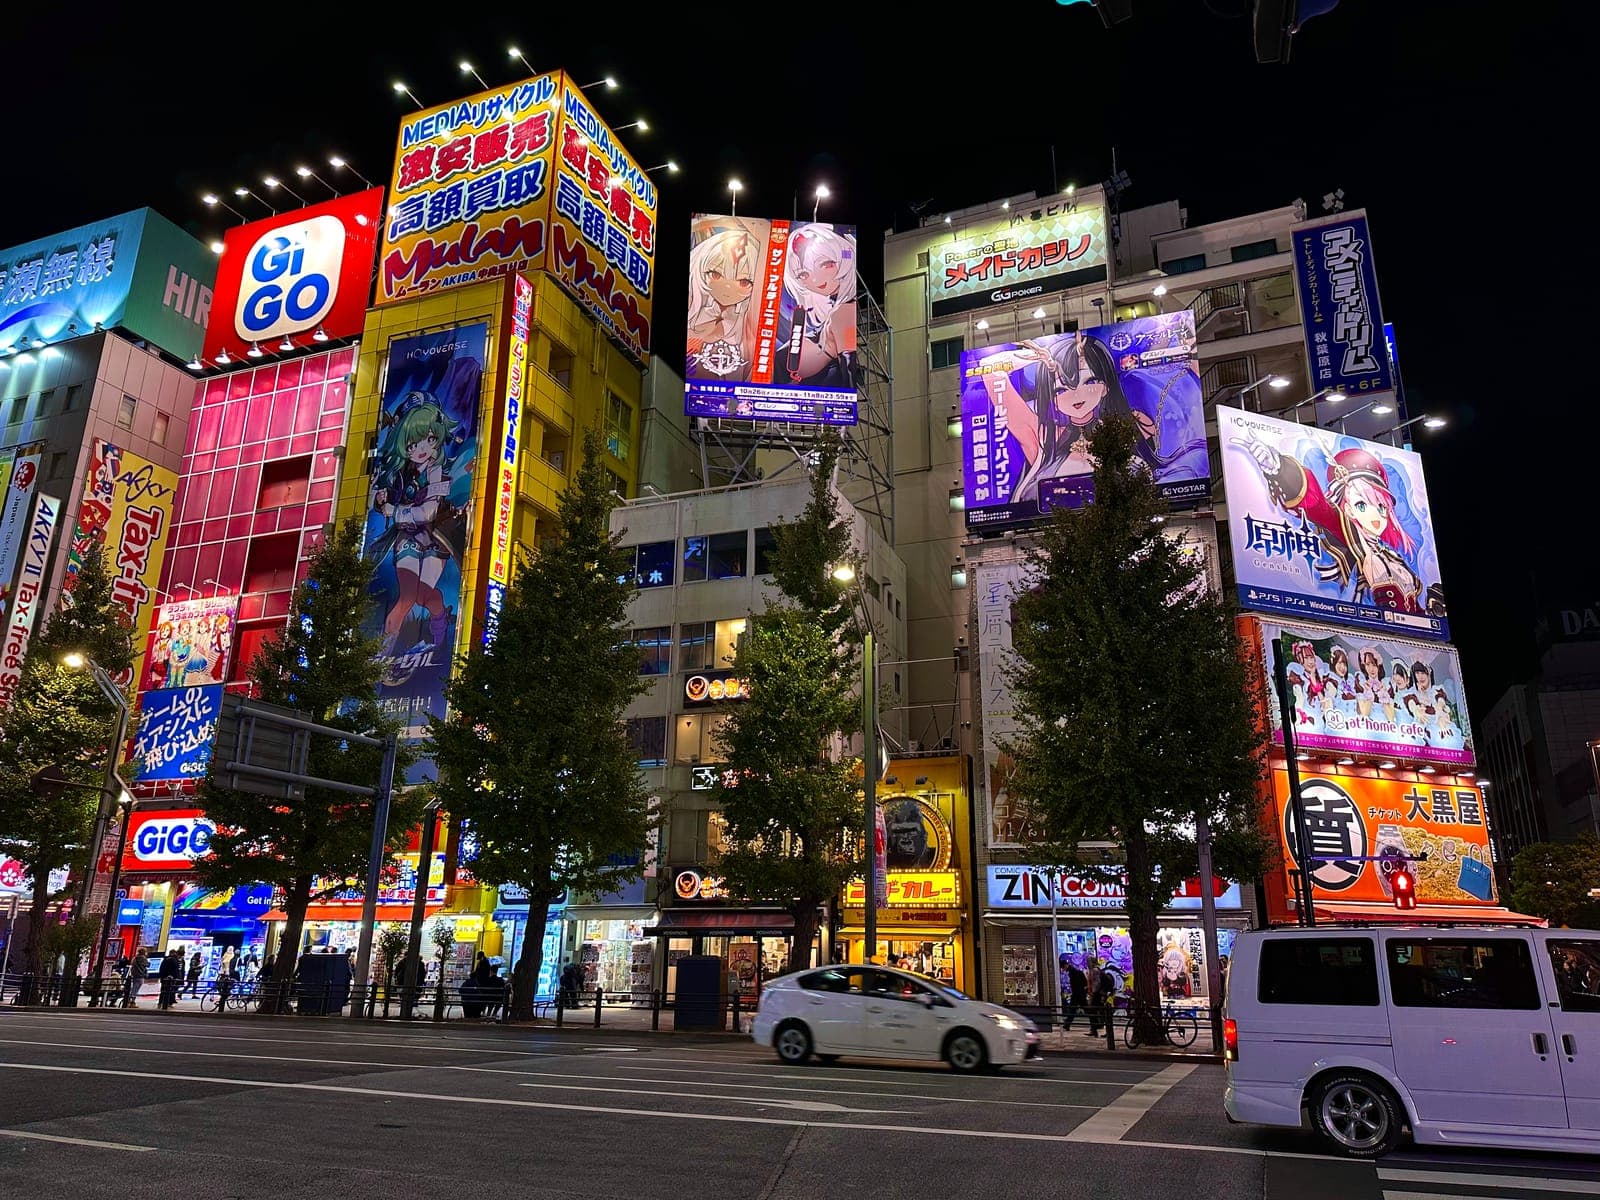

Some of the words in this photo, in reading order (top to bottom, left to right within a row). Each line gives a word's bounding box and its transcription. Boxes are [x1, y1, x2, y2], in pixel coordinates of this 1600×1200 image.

[403, 76, 553, 148] MEDIAリサイクル
[397, 112, 548, 190] 激安販売
[564, 88, 656, 208] MEDIAリサイクル
[388, 160, 547, 242] 高額買取
[560, 123, 655, 251] 激安販売
[252, 236, 306, 283] Gi
[383, 217, 545, 298] Mulan
[554, 171, 650, 295] 高額買取
[943, 233, 1092, 289] メイドカジノ
[243, 273, 331, 332] GO
[441, 270, 477, 288] AKIBA
[552, 223, 651, 353] Mulan
[1321, 226, 1381, 377] アメニティドリーム
[1313, 331, 1333, 380] 秋葉原店
[993, 379, 1010, 499] ゴールデン・ハインド
[1171, 484, 1206, 496] YOSTAR
[1243, 509, 1322, 584] 原神
[1253, 558, 1301, 574] Genshin
[4, 582, 39, 669] Tax-free
[1310, 600, 1335, 612] Windows
[140, 686, 203, 733] ゲームの
[1399, 721, 1425, 738] cafe
[1295, 796, 1362, 878] 質
[1368, 806, 1403, 820] チケット
[1404, 787, 1483, 826] 大黒屋
[995, 871, 1052, 906] ZIN
